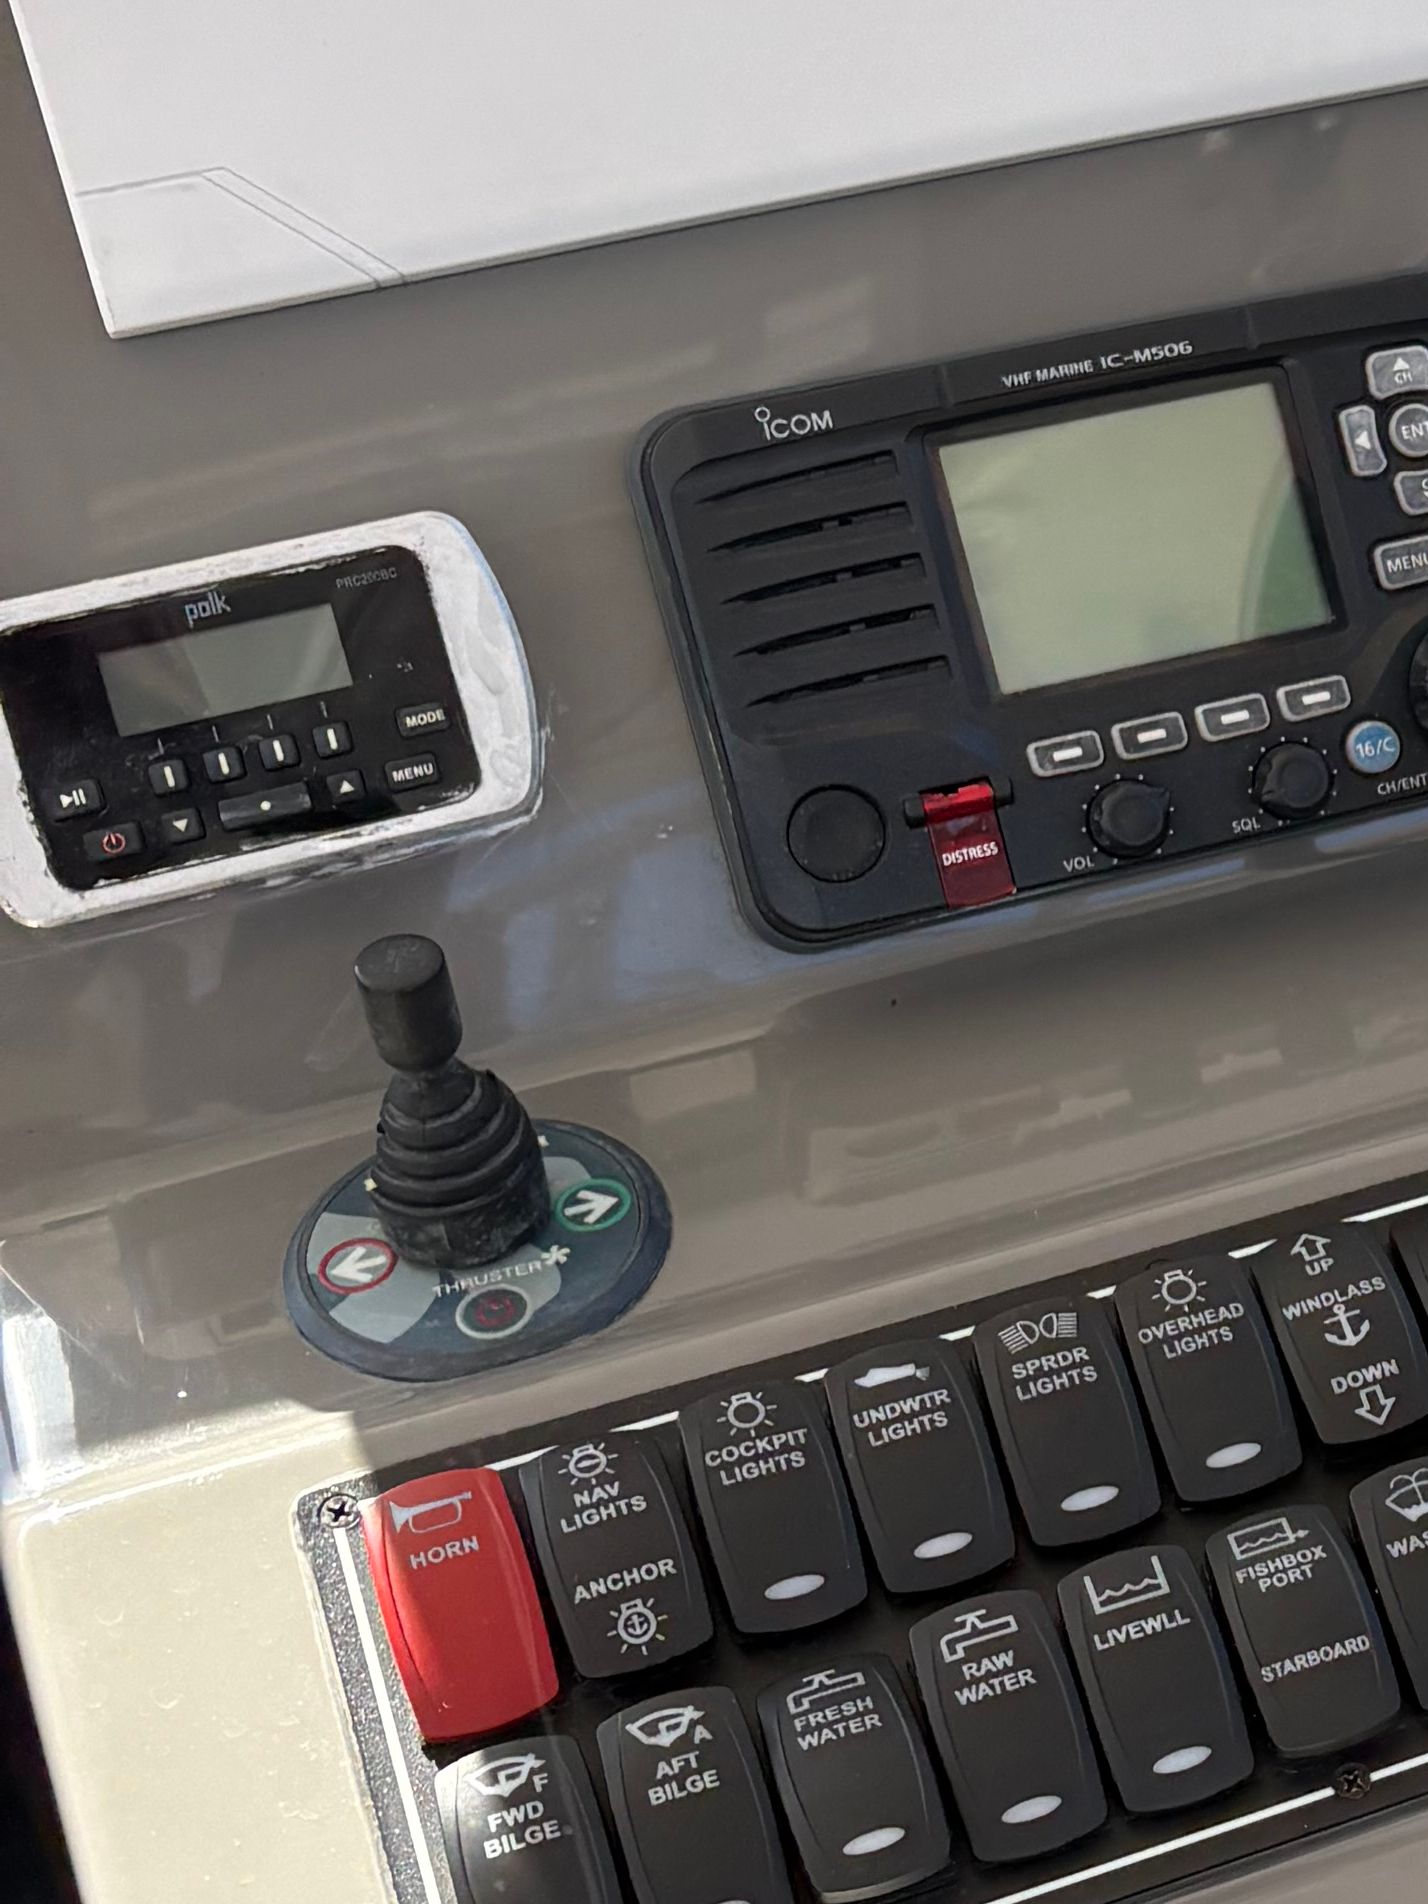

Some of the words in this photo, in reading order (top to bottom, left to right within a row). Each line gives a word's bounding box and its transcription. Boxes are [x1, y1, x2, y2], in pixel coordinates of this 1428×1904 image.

[1001, 368, 1032, 389] VHF
[1035, 358, 1094, 382] MARINE
[1099, 340, 1193, 370] IC-M506
[184, 592, 232, 629] polk
[405, 708, 446, 729] MODE
[1355, 736, 1396, 759] 16/C
[391, 761, 434, 782] MENU
[1377, 774, 1428, 796] CH/ENT
[1232, 817, 1261, 834] SQL
[941, 841, 999, 867] DISTRESS
[1062, 854, 1096, 873] VOL
[431, 1259, 543, 1298] THRUSTER
[1305, 1257, 1334, 1277] UP
[1282, 1276, 1386, 1321] WINDLASS
[1138, 1302, 1244, 1345] OVERHEAD
[1162, 1326, 1234, 1359] LIGHTS
[1011, 1346, 1090, 1380] SPRDR
[1330, 1359, 1400, 1395] DOWN
[1015, 1365, 1098, 1401] LIGHTS
[853, 1389, 951, 1429] UNDWTR
[867, 1411, 949, 1447] LIGHTS
[705, 1428, 808, 1467] COCKPIT
[719, 1450, 806, 1486] LIGHTS
[573, 1481, 621, 1508] NAV
[560, 1495, 647, 1533] LIGHTS
[409, 1535, 480, 1570] HORN
[1235, 1544, 1327, 1584] FISHBOX
[573, 1557, 677, 1604] ANCHOR
[1258, 1564, 1315, 1593] PORT
[1093, 1609, 1191, 1651] LIVEWLL
[961, 1649, 1014, 1681] RAW
[1261, 1634, 1371, 1683] STARBOARD
[954, 1668, 1037, 1706] WATER
[793, 1695, 874, 1732] FRESH
[693, 1724, 713, 1745] A
[796, 1713, 883, 1751] WATER
[532, 1772, 549, 1793] F
[655, 1751, 700, 1780] AFT
[648, 1769, 720, 1806] BILGE
[487, 1800, 545, 1833] FWD
[483, 1819, 562, 1860] BILGE
